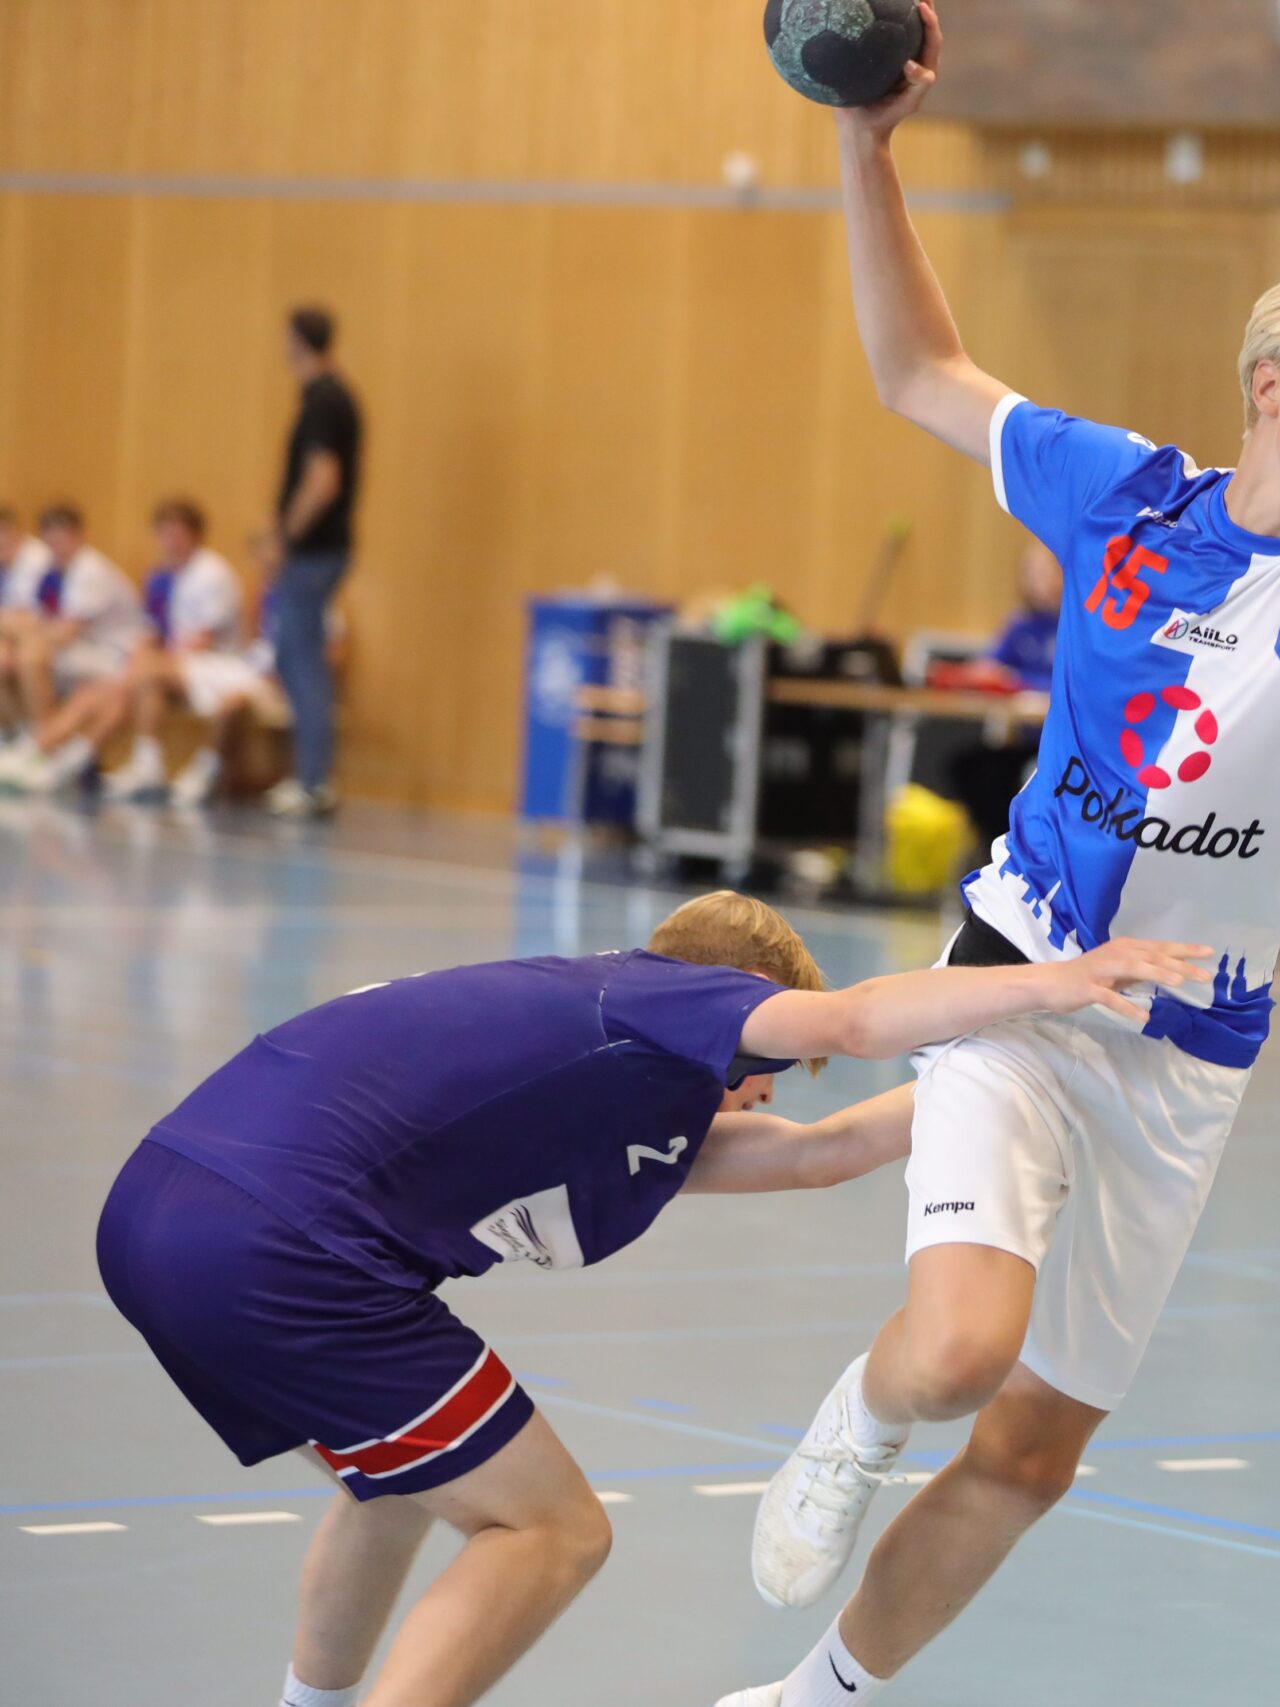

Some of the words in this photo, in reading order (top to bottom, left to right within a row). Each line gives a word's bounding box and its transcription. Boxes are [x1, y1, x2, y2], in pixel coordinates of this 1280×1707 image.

[1084, 534, 1169, 631] 15
[1054, 756, 1265, 859] Polkadot
[626, 1136, 688, 1176] 2
[924, 1201, 975, 1217] Kempa
